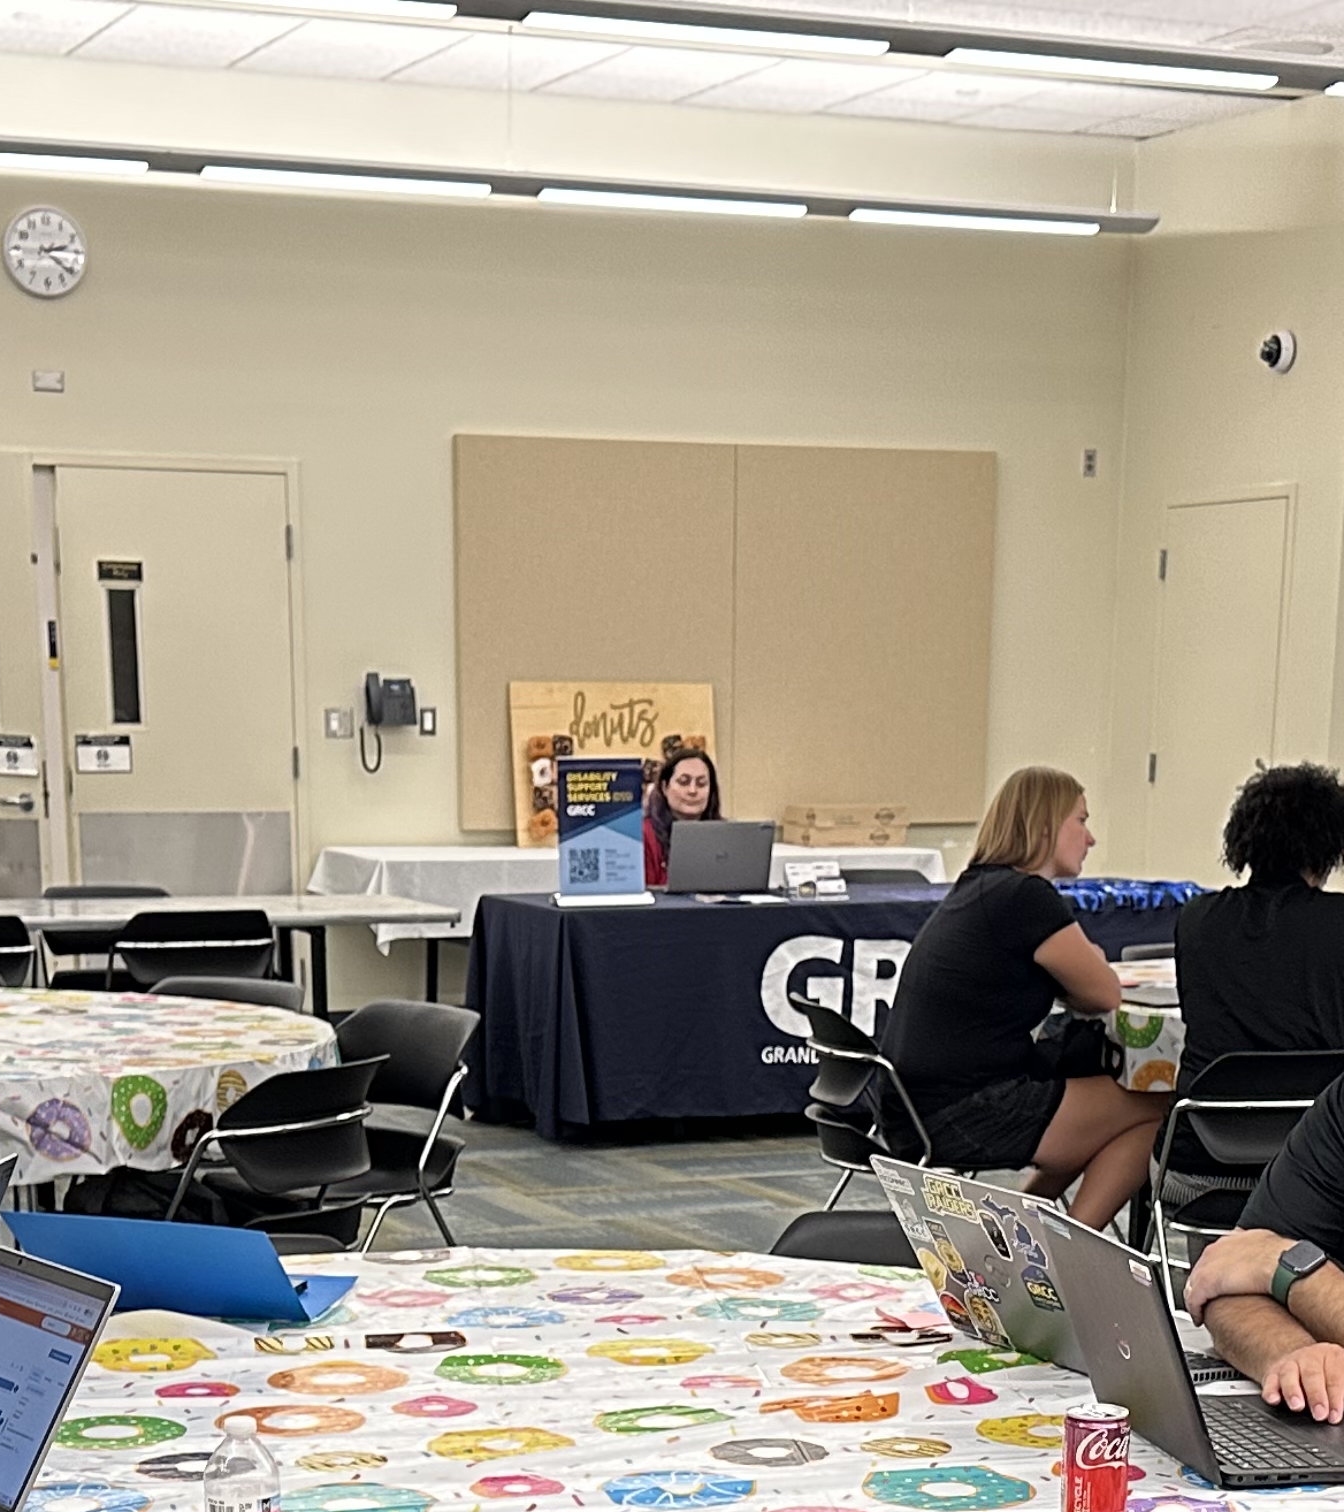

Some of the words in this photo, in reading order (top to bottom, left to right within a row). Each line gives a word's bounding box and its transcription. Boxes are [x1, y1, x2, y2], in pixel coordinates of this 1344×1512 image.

[569, 690, 659, 750] donuts
[566, 772, 618, 782] DISABILITY
[566, 782, 609, 792] SUPPORT
[566, 803, 596, 816] GRCC
[926, 1192, 976, 1219] RAIDERS
[1027, 1281, 1058, 1301] GRCC
[1076, 1428, 1129, 1470] Coca
